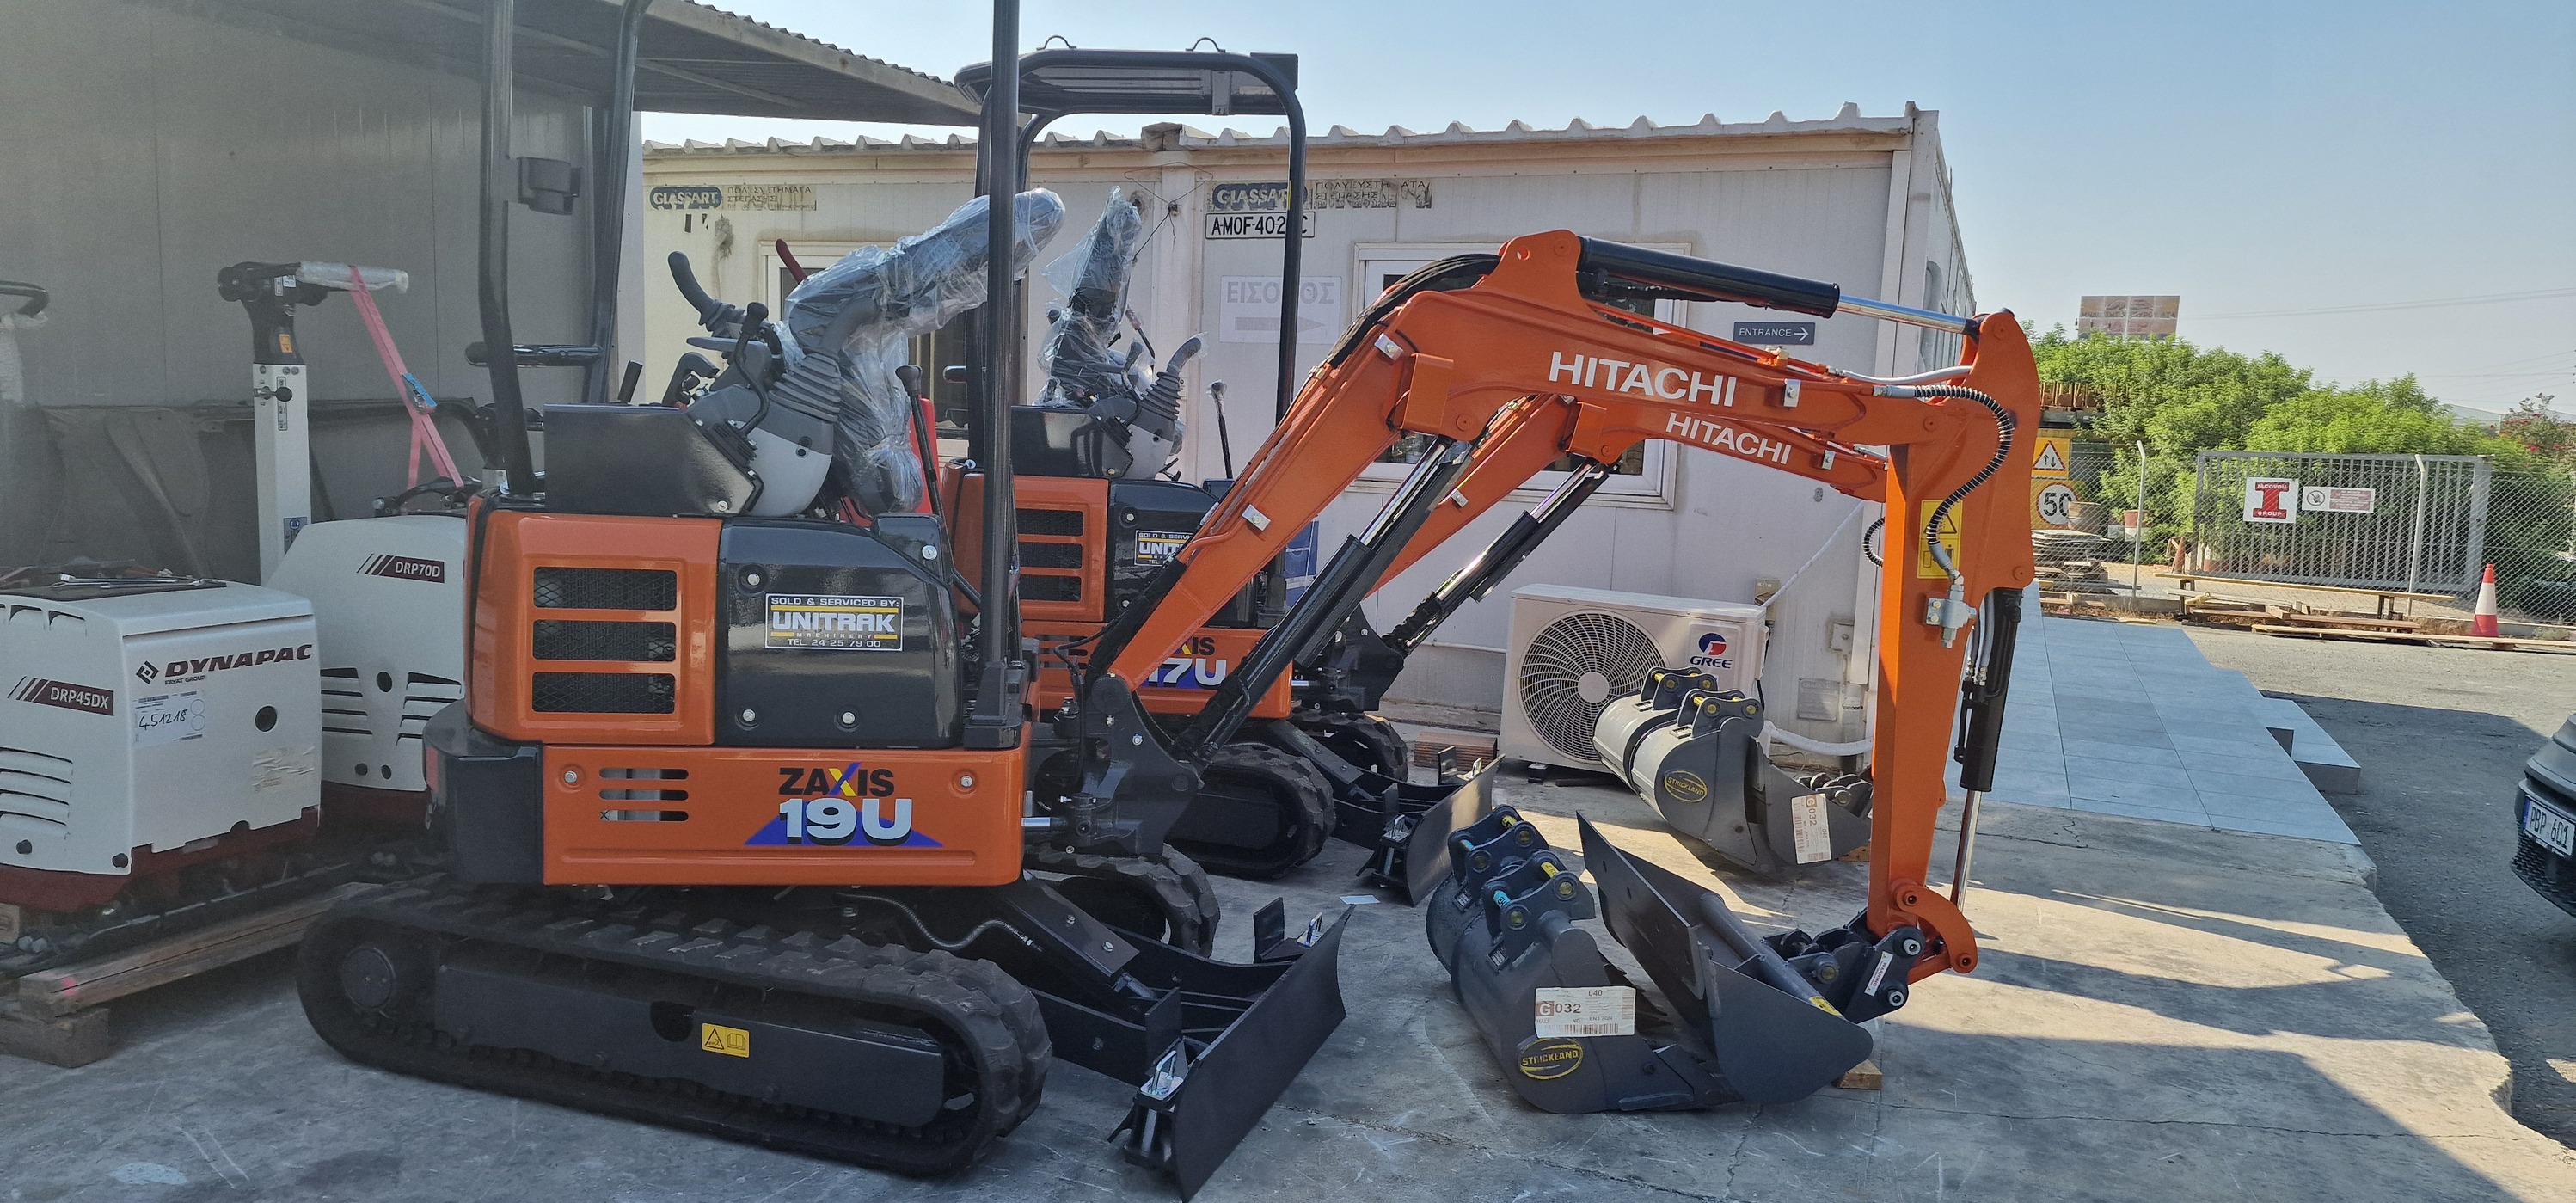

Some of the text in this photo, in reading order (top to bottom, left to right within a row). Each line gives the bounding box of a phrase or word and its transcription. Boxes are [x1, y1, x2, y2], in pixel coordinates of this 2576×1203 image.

[1227, 281, 1335, 304] ΕΙΣΟΟΣ
[1739, 328, 1792, 337] ENTRANCE
[1549, 351, 1737, 407] HITACHI
[1665, 412, 1792, 465] HITACHI
[2044, 492, 2073, 517] 50
[1139, 542, 1182, 555] UNIT
[396, 562, 441, 578] DRP70D
[770, 597, 802, 605] SOLD
[819, 598, 876, 607] SERVICED
[772, 611, 896, 633] UNITRAK
[164, 644, 312, 678] DYNAPAC
[1690, 655, 1733, 669] GREE
[185, 674, 206, 683] GROUP
[50, 686, 109, 709] DRP45DX
[778, 762, 895, 797] ZAXIS
[779, 797, 912, 846] 19U
[2530, 806, 2548, 834] PBP
[2550, 819, 2569, 850] 601
[1522, 1050, 1579, 1066] STRICKLAND
